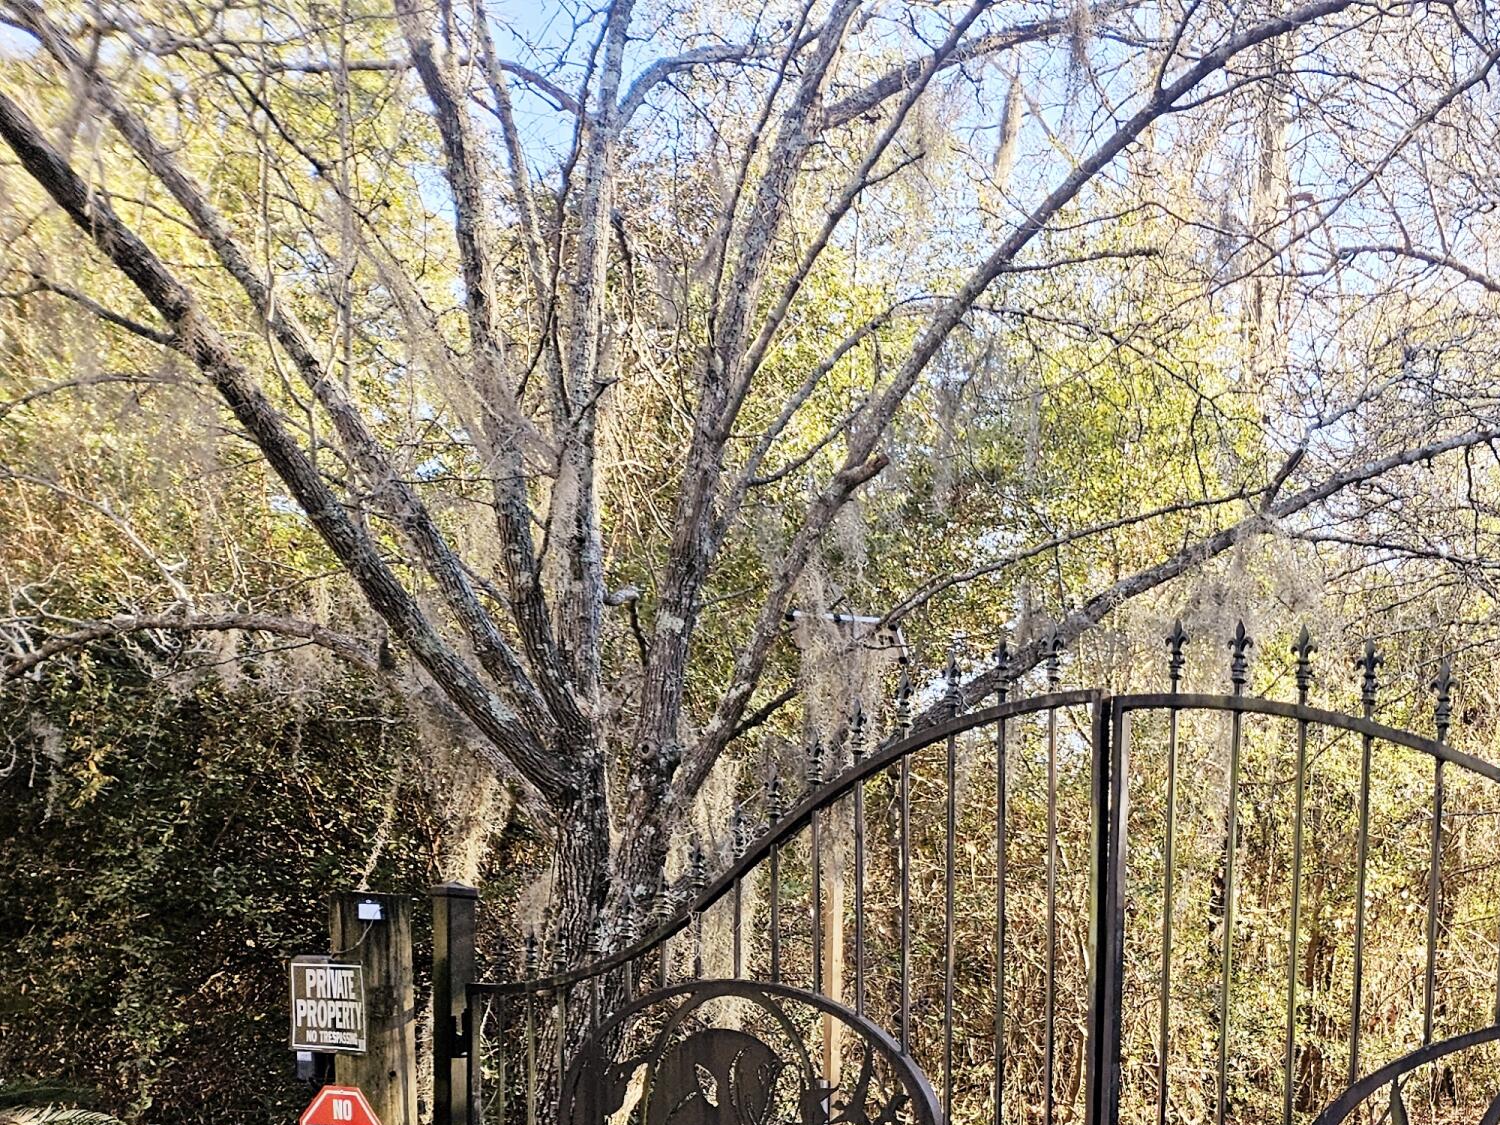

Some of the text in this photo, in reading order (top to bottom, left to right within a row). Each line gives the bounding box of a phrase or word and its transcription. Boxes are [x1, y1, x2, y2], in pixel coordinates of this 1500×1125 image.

[305, 968, 356, 999] PRIVATE
[296, 998, 362, 1030] PROPERTY
[305, 1030, 318, 1043] NO
[332, 1099, 352, 1121] NO
